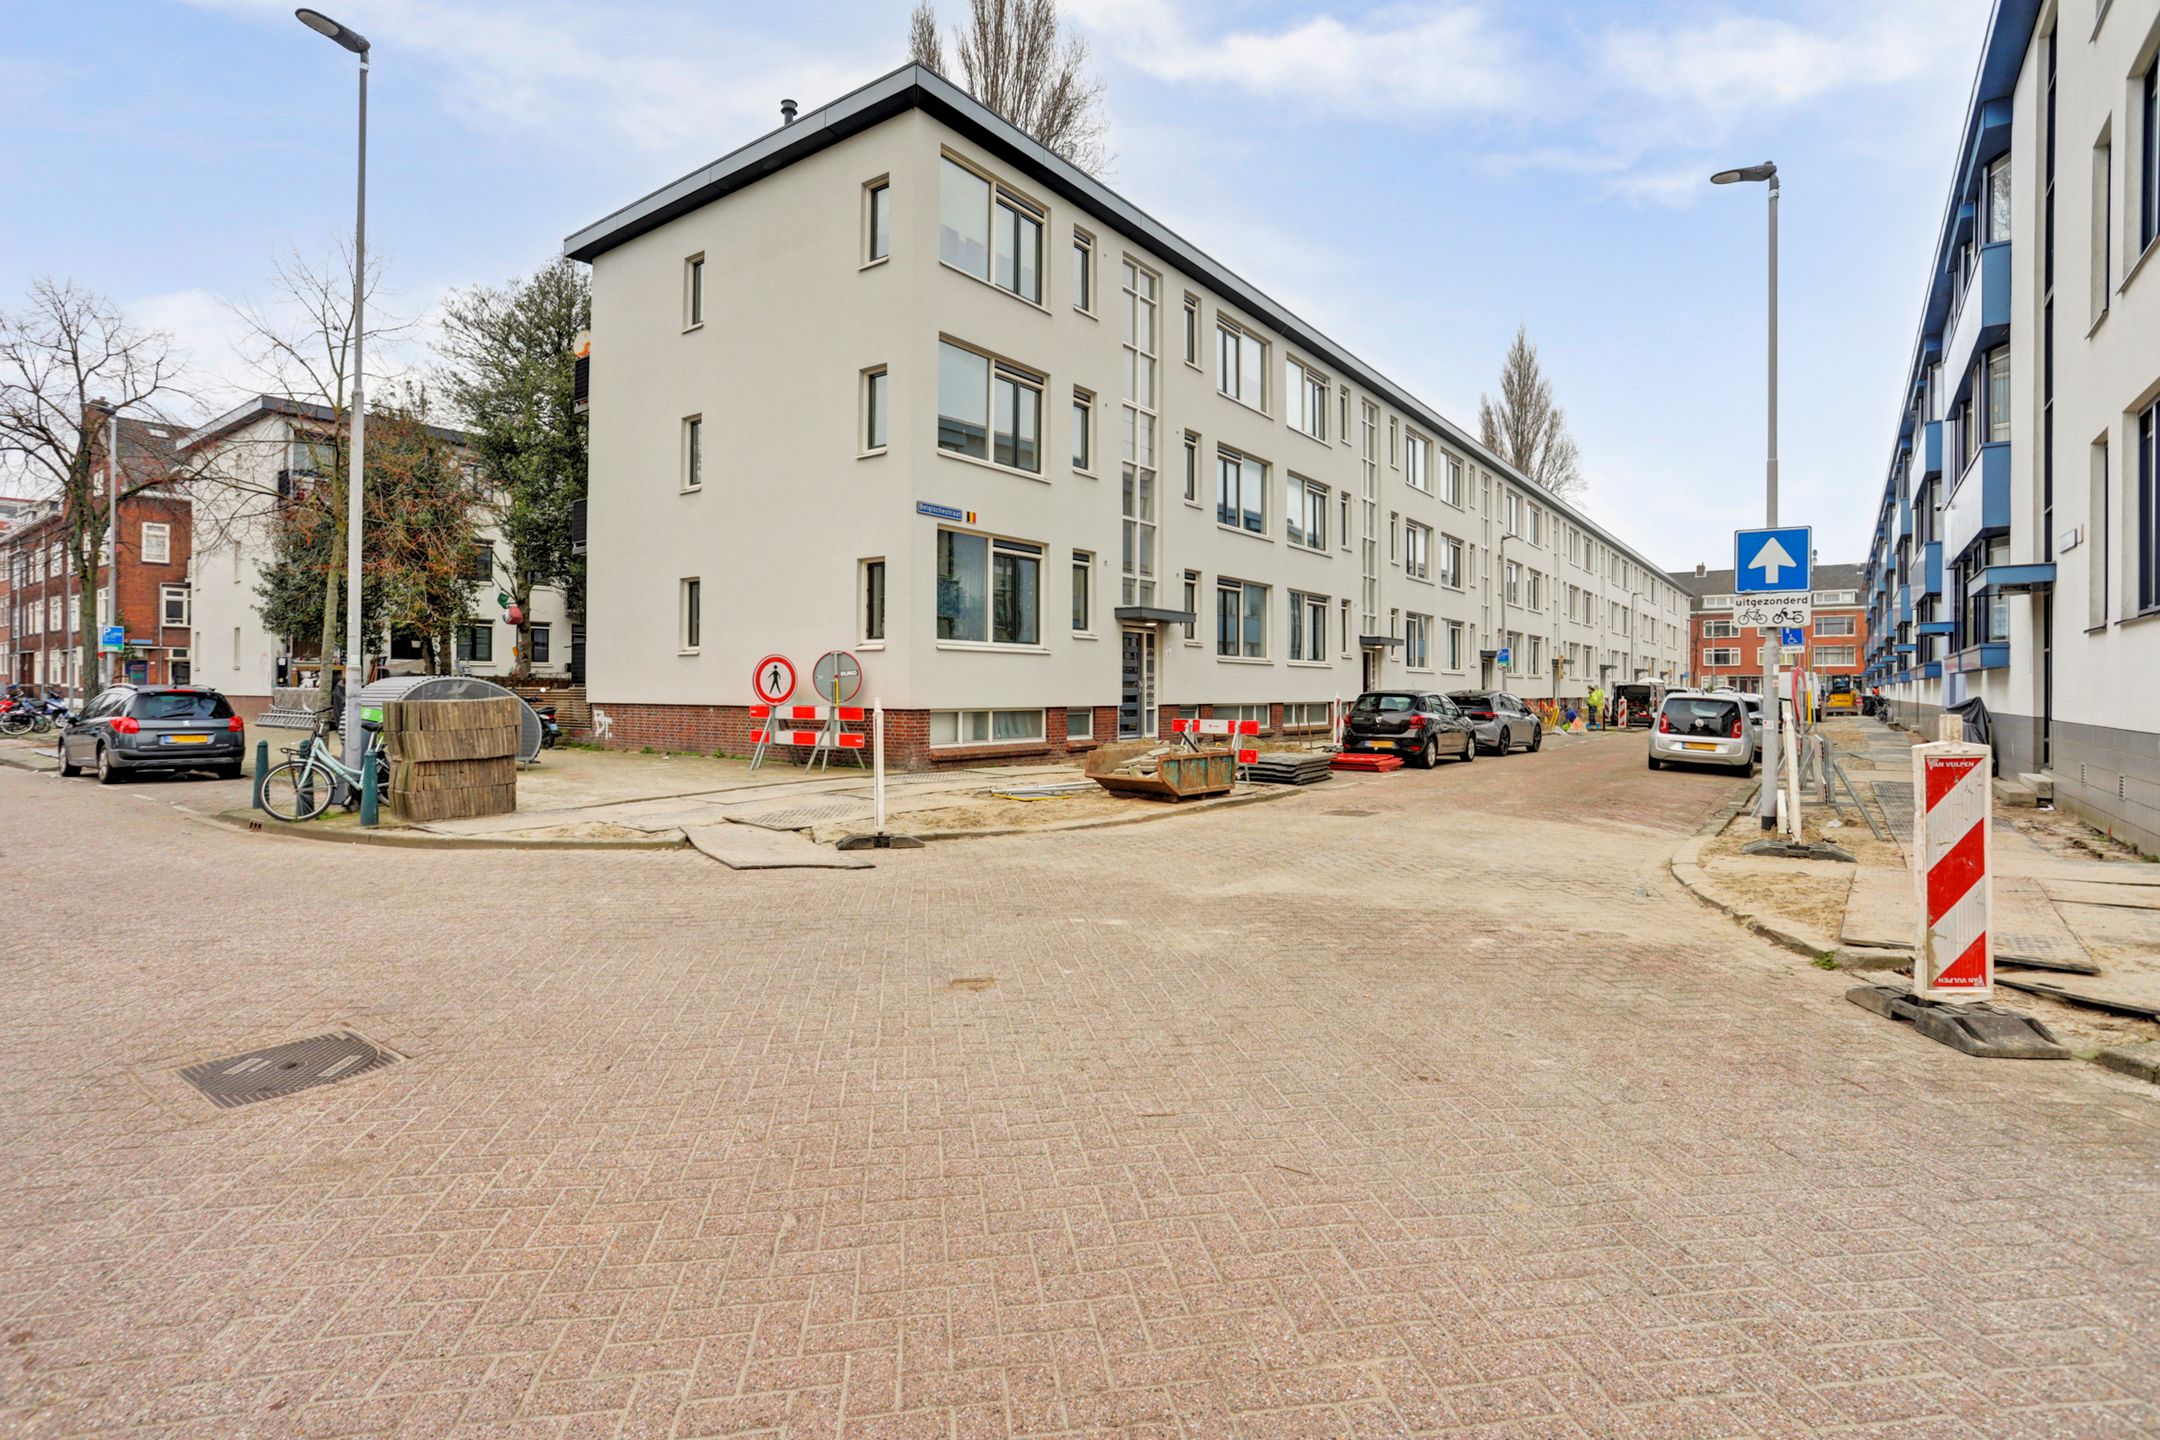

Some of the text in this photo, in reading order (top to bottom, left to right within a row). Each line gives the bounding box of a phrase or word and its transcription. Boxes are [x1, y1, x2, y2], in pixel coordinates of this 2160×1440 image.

[1735, 596, 1808, 608] uitgezonderd
[1926, 758, 1945, 771] VAN
[1967, 974, 1985, 987] VAN
